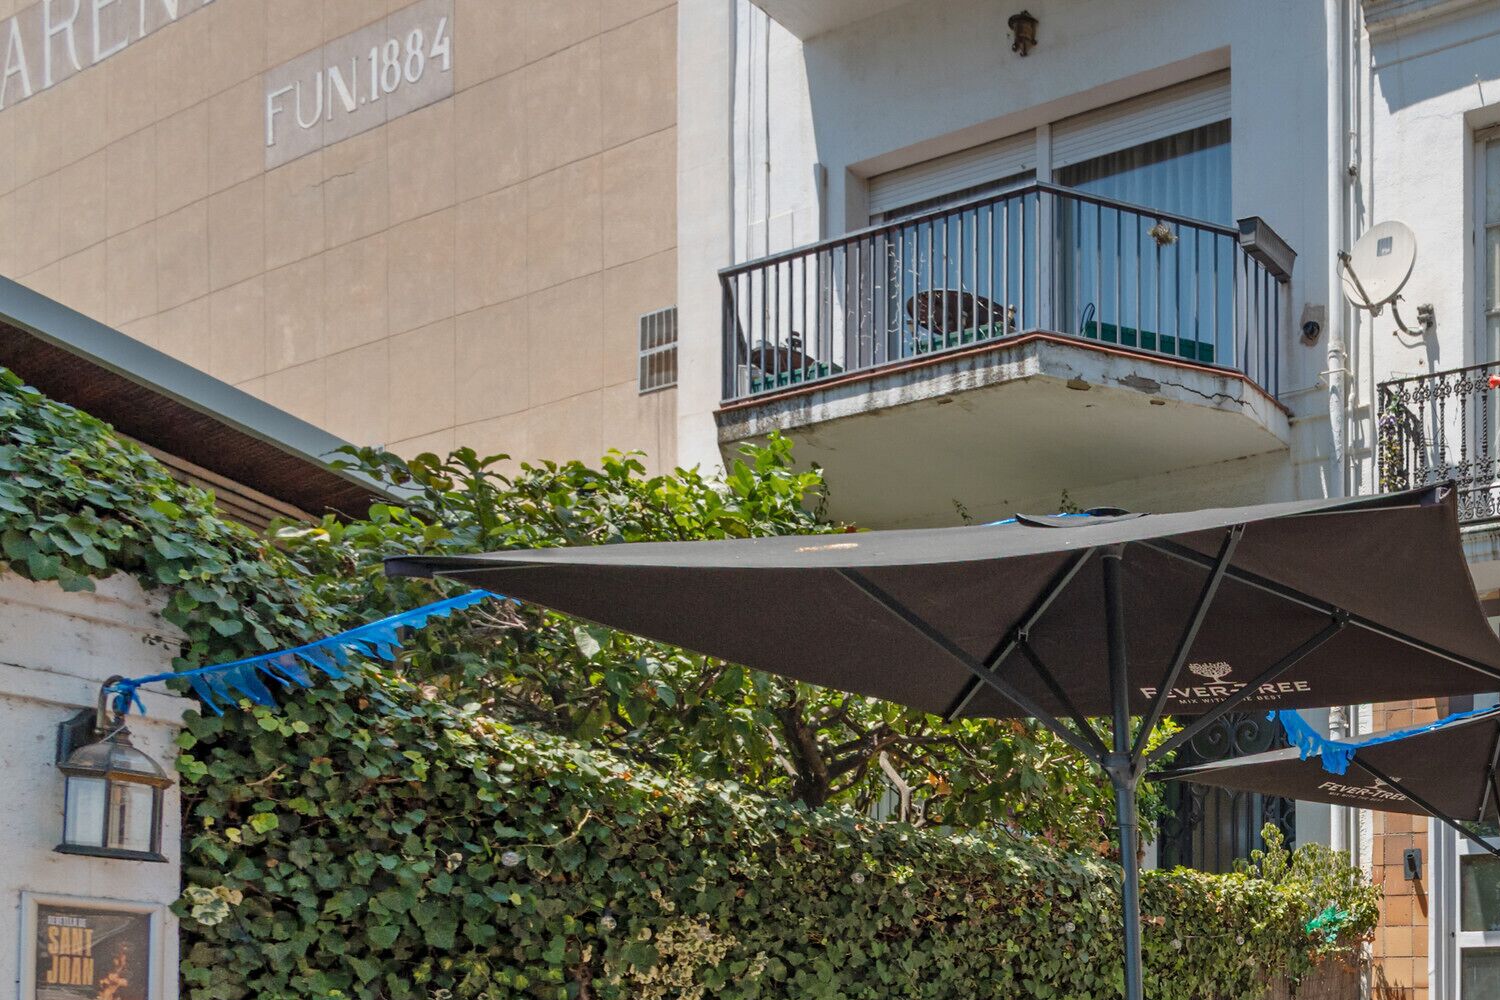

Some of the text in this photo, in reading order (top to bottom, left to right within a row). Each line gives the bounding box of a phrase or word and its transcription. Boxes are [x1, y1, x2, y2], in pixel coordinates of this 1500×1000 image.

[1317, 781, 1408, 801] FEVER-TREE
[47, 925, 94, 958] SANT
[46, 955, 95, 986] JOAN
